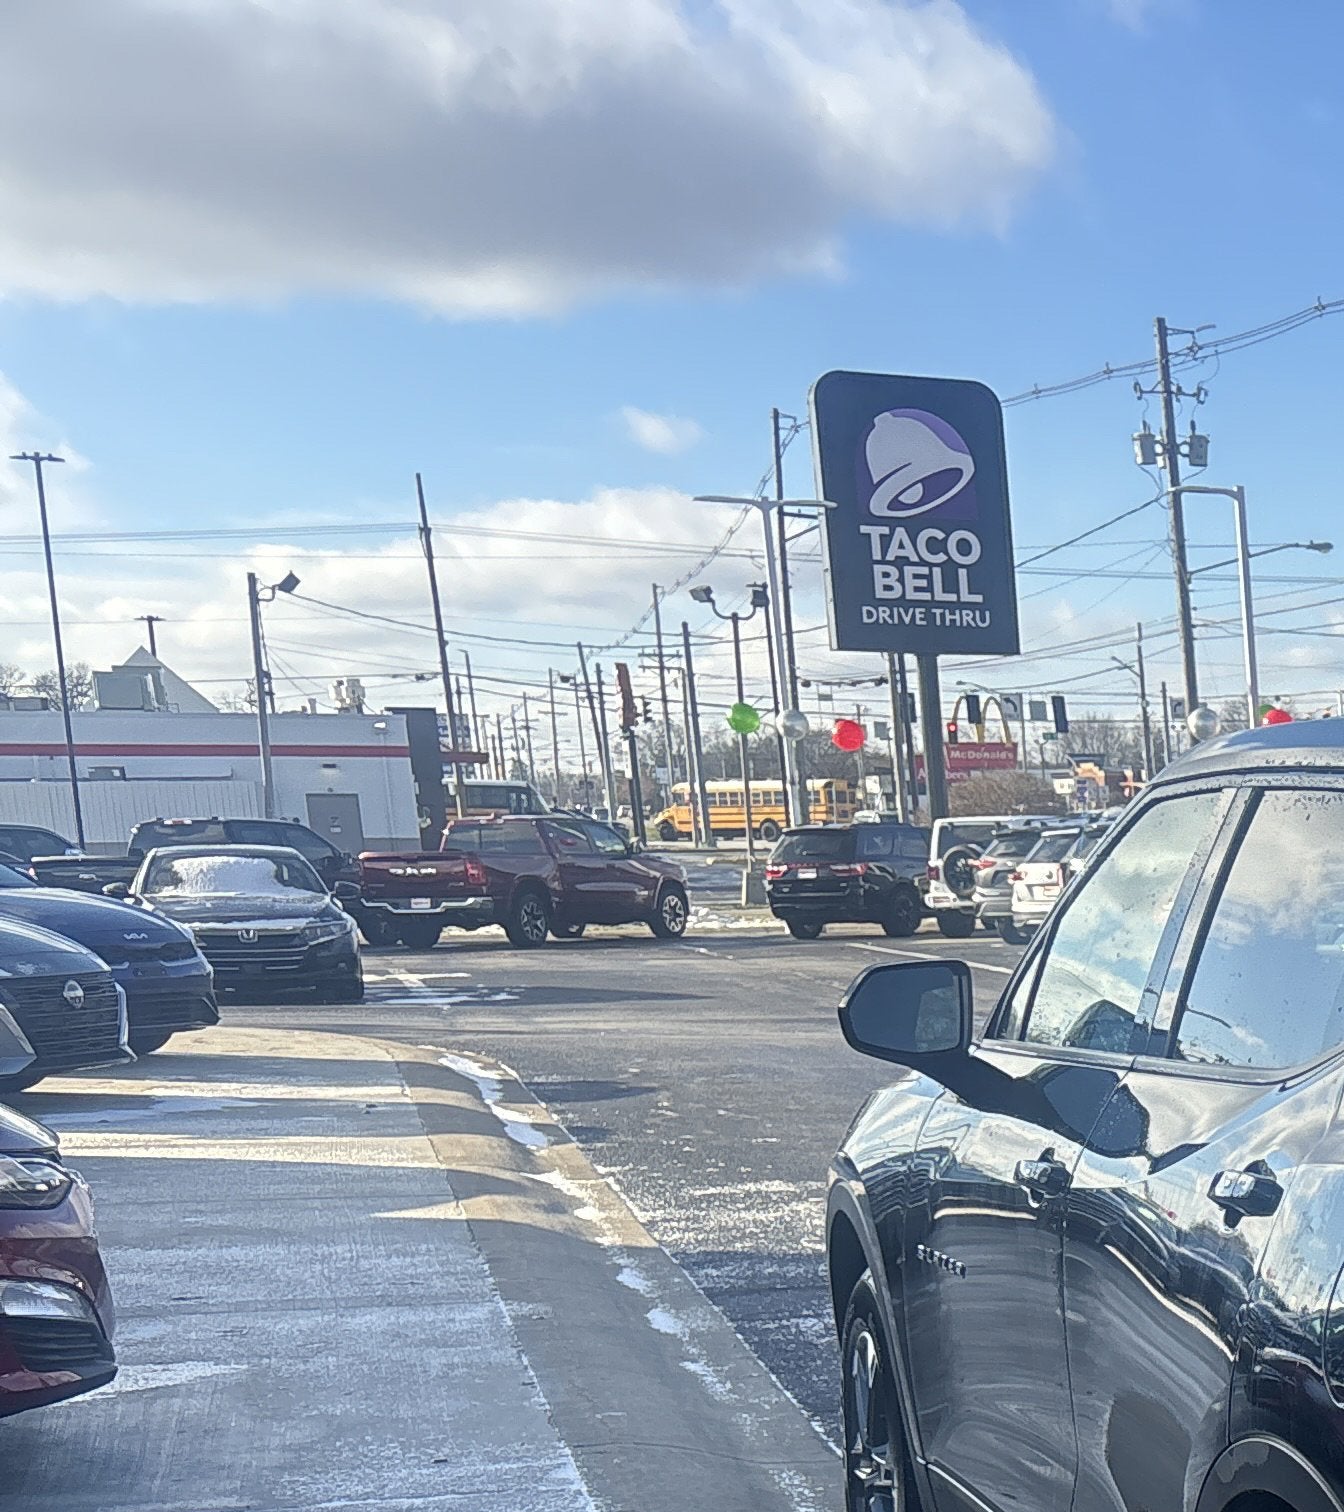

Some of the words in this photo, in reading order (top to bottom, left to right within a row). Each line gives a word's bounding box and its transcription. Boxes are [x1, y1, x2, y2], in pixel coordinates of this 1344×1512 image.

[859, 524, 982, 566] TACO
[873, 563, 984, 604] BELL
[861, 605, 928, 626] DRIVE
[931, 608, 991, 629] THRU
[950, 750, 1015, 761] McDonald's
